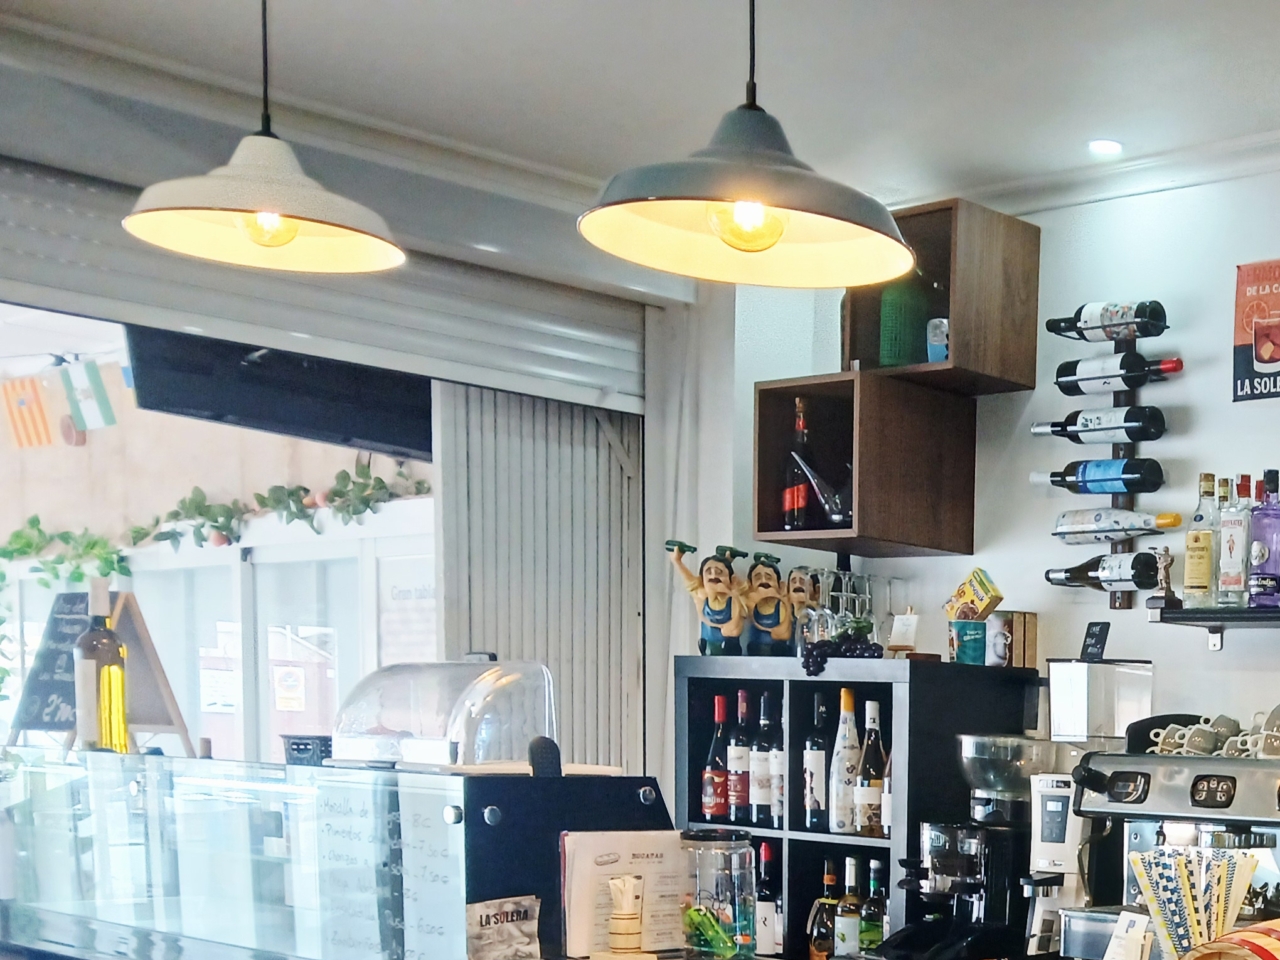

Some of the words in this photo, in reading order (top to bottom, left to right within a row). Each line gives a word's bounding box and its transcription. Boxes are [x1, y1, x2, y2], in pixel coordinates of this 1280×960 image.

[1246, 286, 1257, 296] DE
[1259, 284, 1270, 295] LA
[1237, 379, 1251, 396] LA
[480, 914, 491, 928] LA
[493, 909, 528, 925] SOLERA
